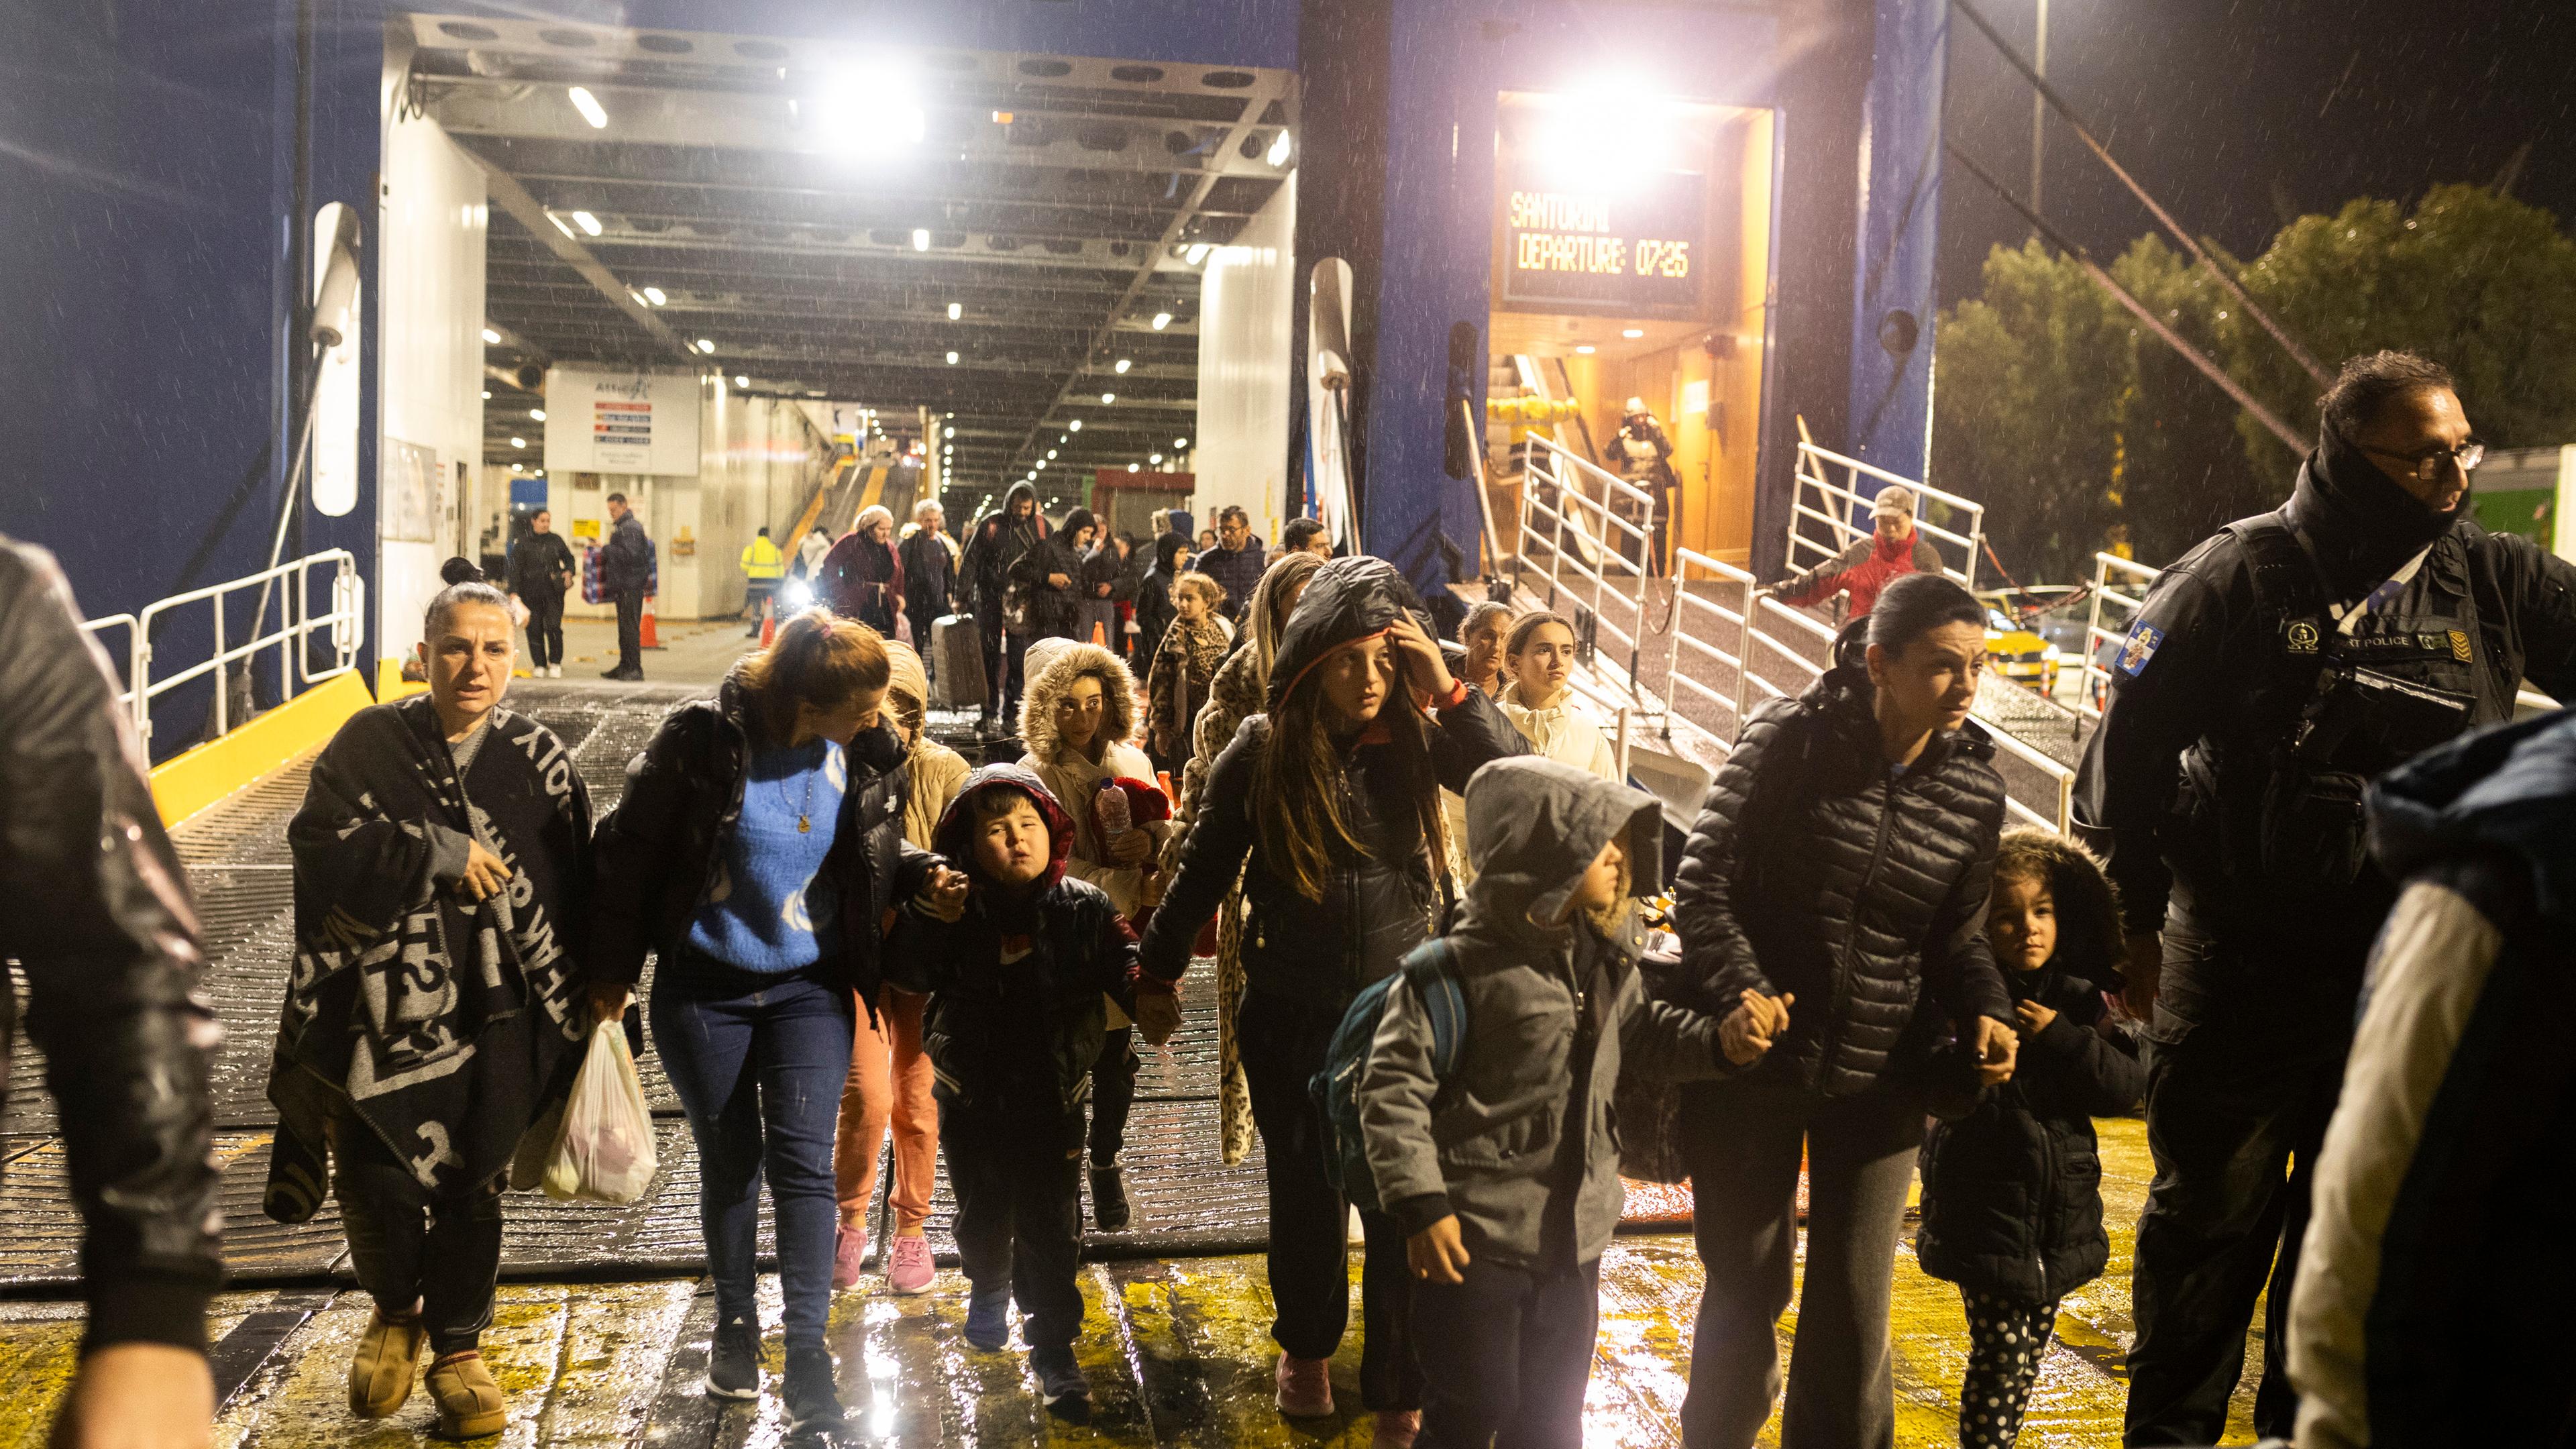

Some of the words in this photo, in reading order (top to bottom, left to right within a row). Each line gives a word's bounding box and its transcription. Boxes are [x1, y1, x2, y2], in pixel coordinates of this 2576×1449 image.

[1518, 232, 1626, 274] DEPARTURE:
[1635, 239, 1689, 277] 07:25
[2364, 636, 2410, 648] POLICE
